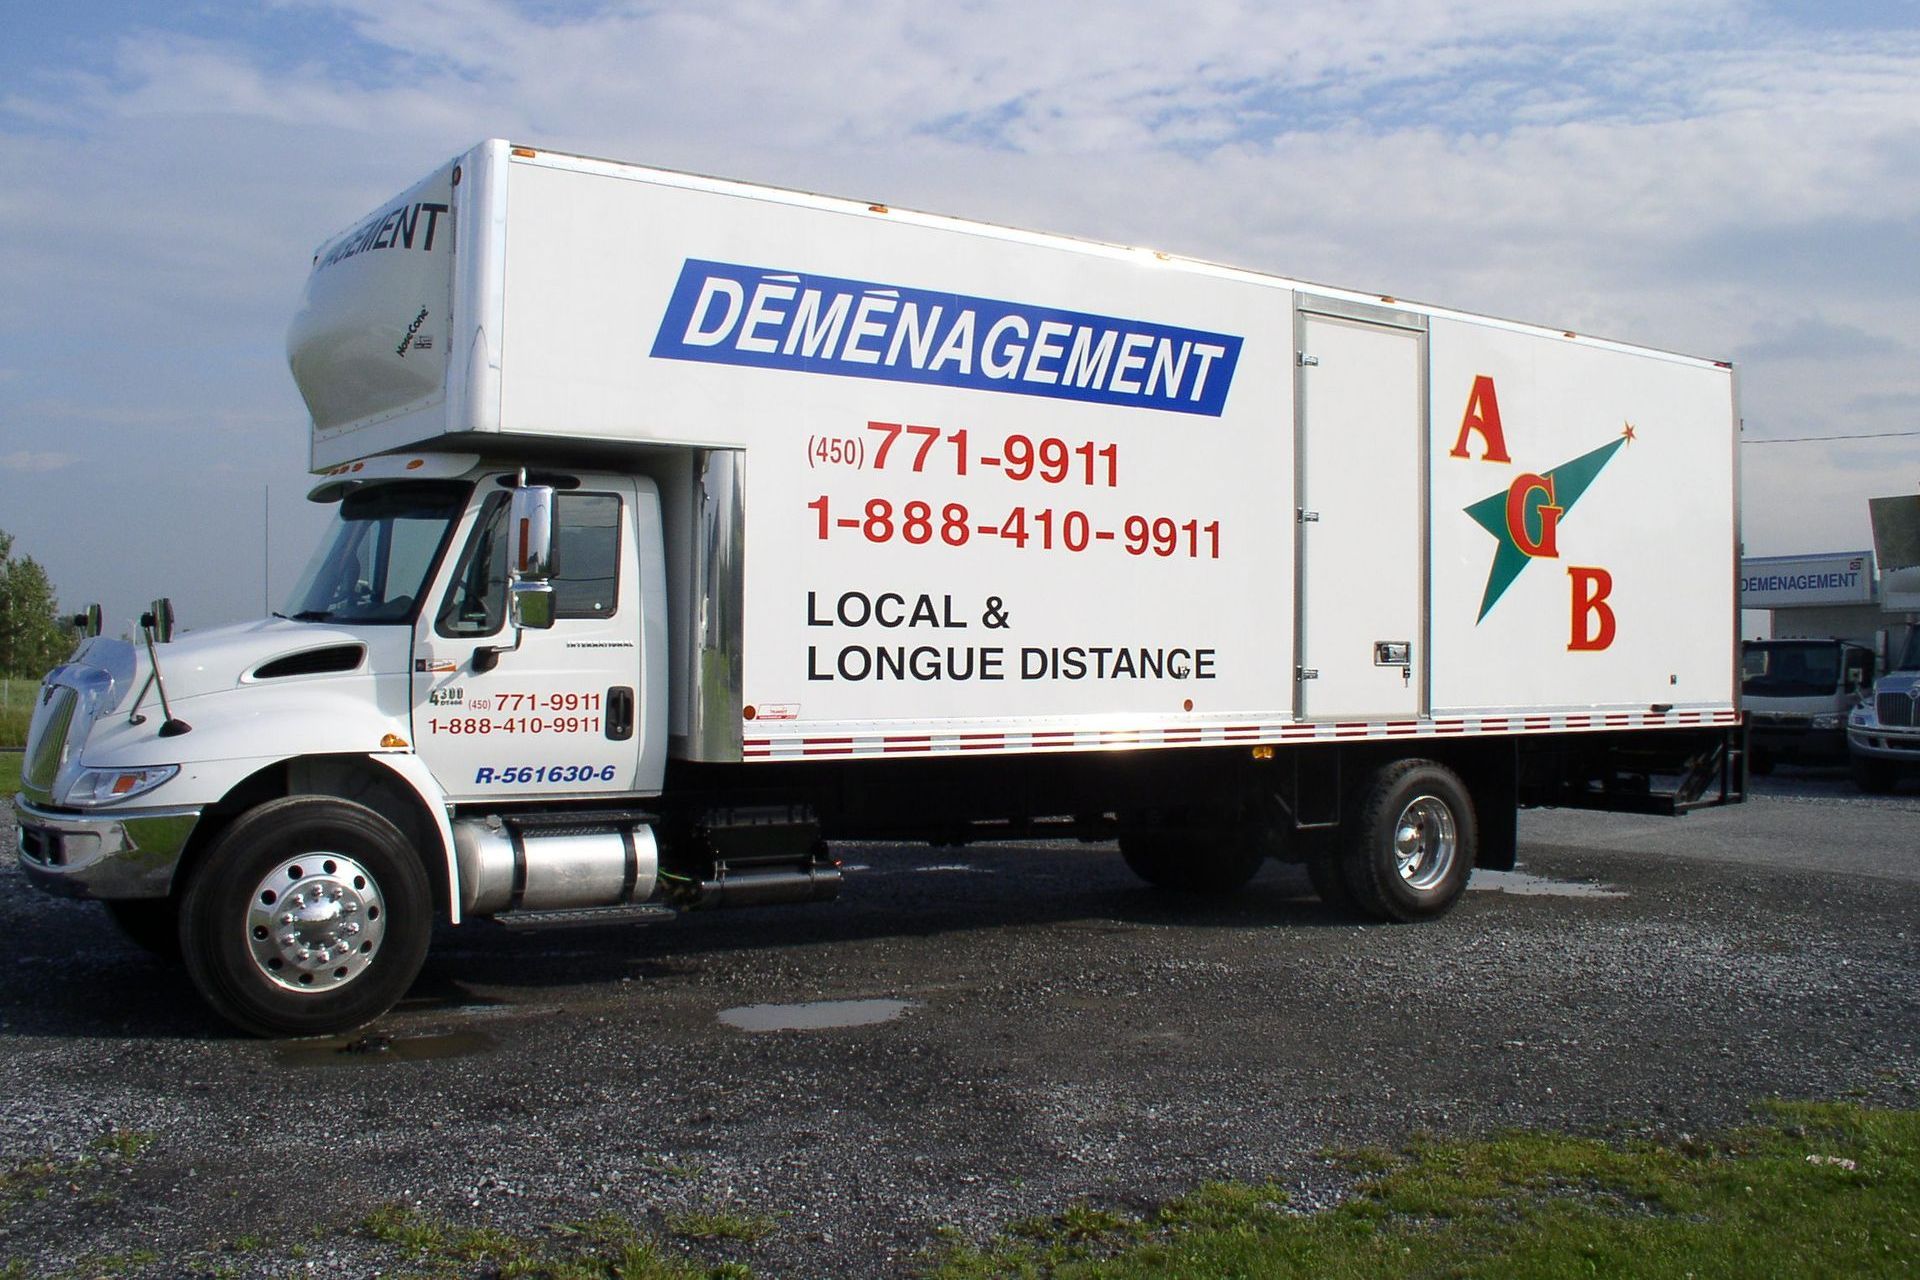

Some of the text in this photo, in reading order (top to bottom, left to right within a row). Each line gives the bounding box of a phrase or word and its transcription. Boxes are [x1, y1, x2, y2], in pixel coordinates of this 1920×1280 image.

[682, 275, 1225, 402] DÉMÉNAGEMENT
[807, 420, 1118, 487] (450) 771-9911
[807, 494, 1220, 559] 1-888-410-9911
[1450, 374, 1616, 652] A G B
[807, 591, 1010, 629] LOCAL &
[807, 645, 1216, 681] LONGUE DISTANCE
[468, 693, 600, 711] (450) 771-9911
[428, 716, 600, 735] 1-888-410-9911
[475, 765, 616, 784] R-561630-6
